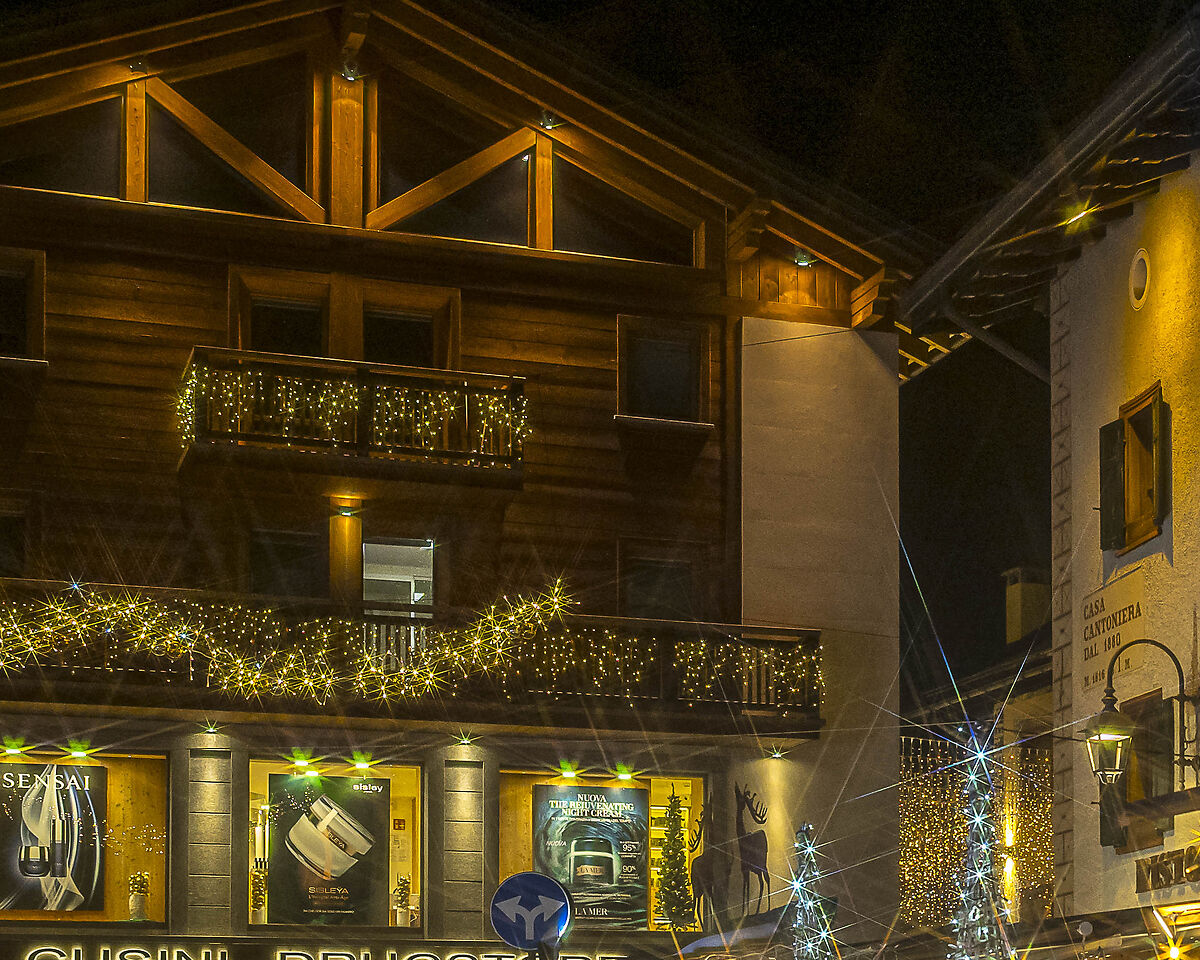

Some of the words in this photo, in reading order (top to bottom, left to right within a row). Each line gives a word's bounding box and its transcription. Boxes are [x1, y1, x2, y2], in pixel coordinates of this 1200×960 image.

[1083, 597, 1105, 620] CASA
[1083, 602, 1142, 642] CANTONIERA
[1084, 643, 1098, 661] DAL
[1104, 633, 1121, 652] 1880
[2, 772, 91, 791] SENSAI
[353, 783, 383, 793] sisley
[577, 793, 606, 802] NUOVA
[549, 800, 569, 809] THE
[570, 801, 635, 811] REJUVENATING
[561, 808, 590, 817] NIGHT
[591, 808, 622, 818] CREAM
[588, 908, 608, 916] MER
